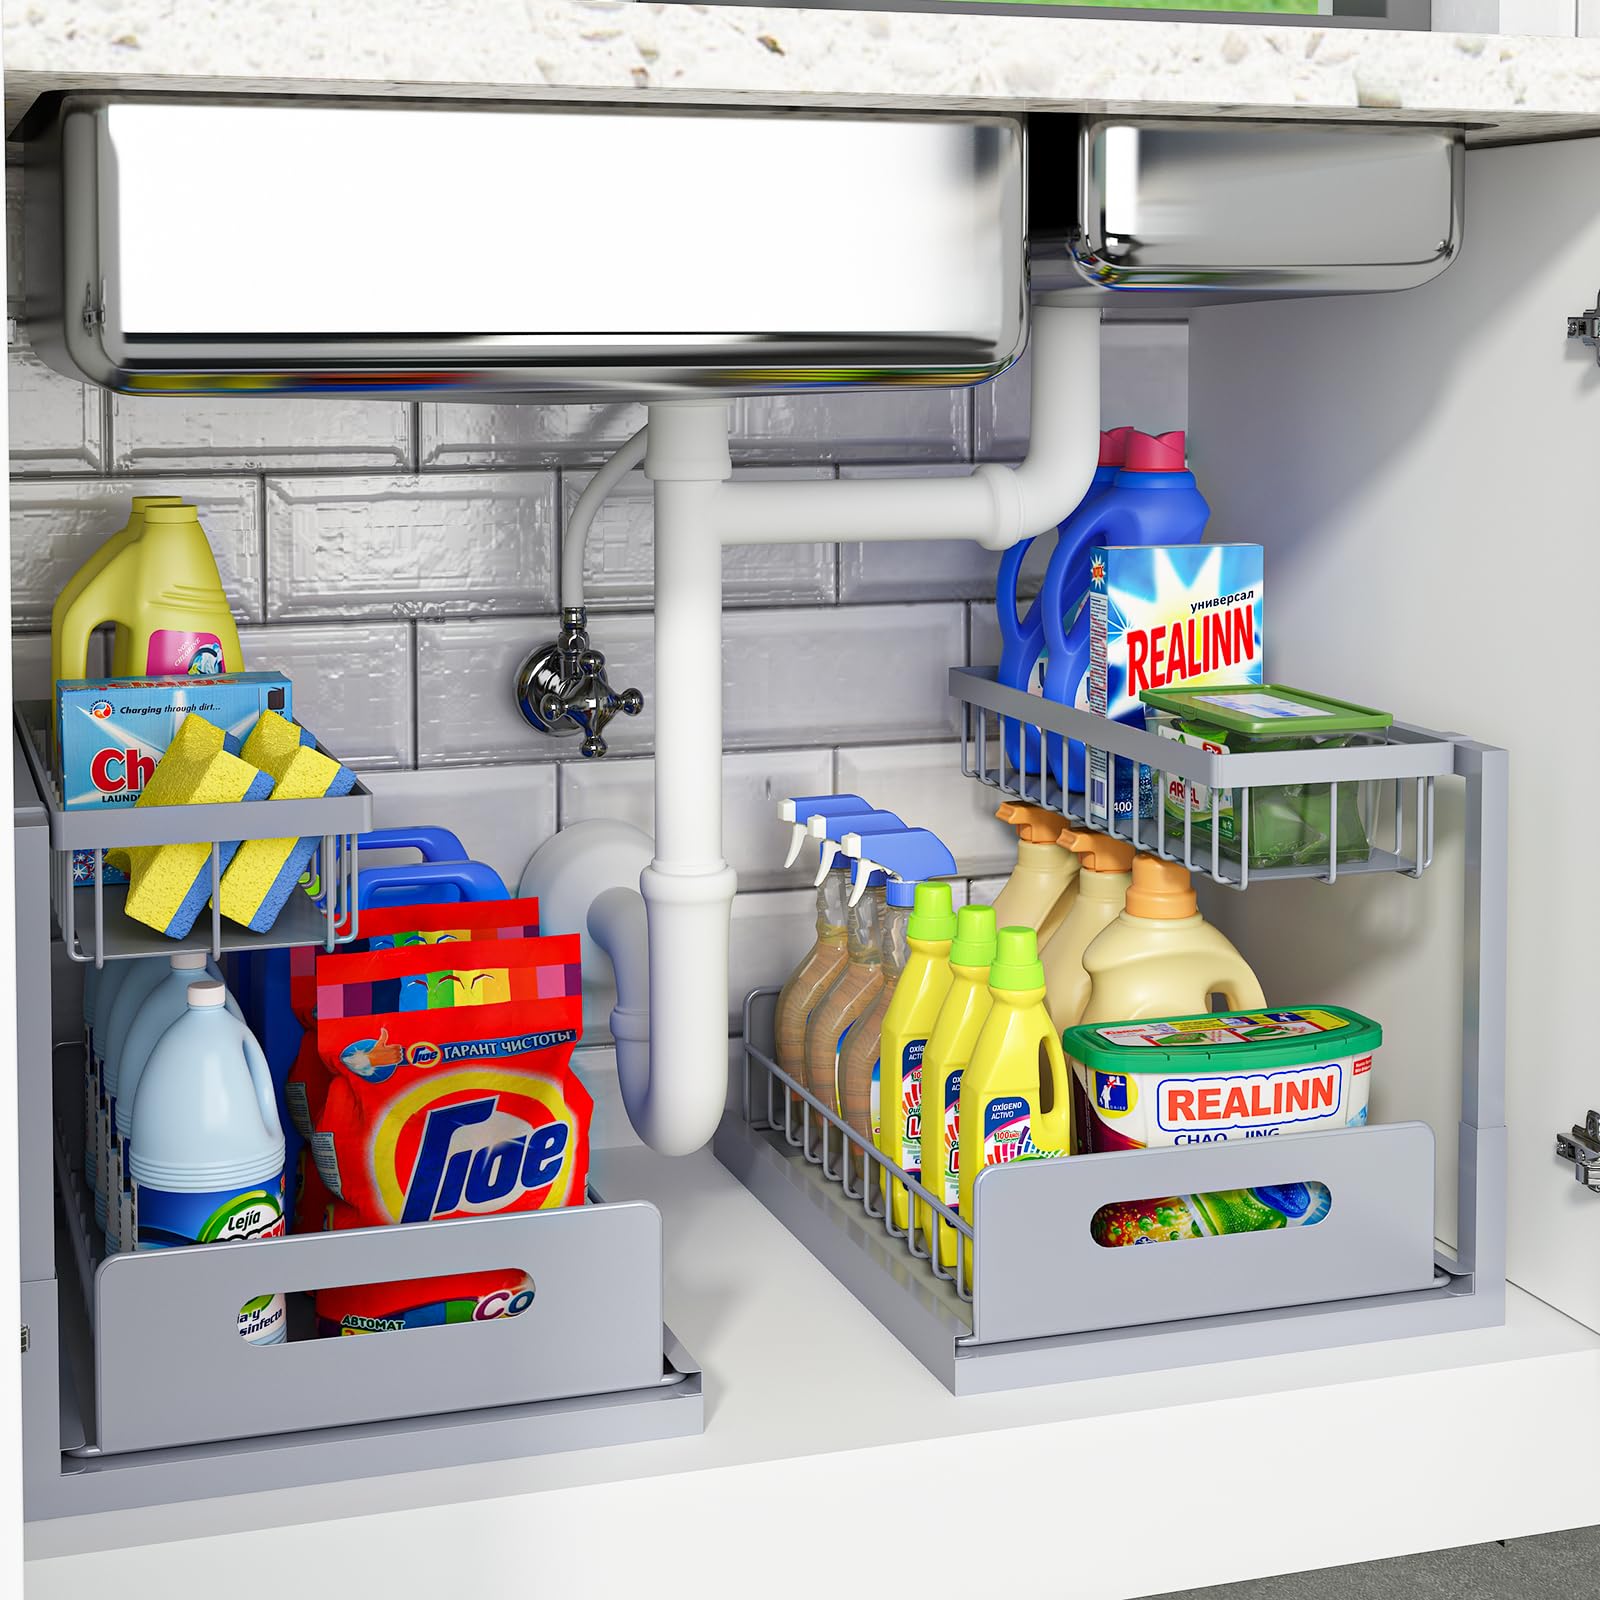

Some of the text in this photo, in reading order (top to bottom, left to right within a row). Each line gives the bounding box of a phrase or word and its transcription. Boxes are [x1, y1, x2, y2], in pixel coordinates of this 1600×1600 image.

[1190, 590, 1254, 614] универсал
[1126, 604, 1254, 697] REALINN
[120, 705, 162, 715] Charging
[164, 703, 197, 713] through
[91, 748, 156, 792] Ch
[102, 794, 141, 803] LAUND
[1169, 780, 1200, 805] ARL
[444, 1042, 498, 1060] ГАРАНТ
[501, 1030, 572, 1053] ЧИСТОТЫ
[991, 1101, 1023, 1112] OXÍGENO
[1167, 1075, 1334, 1122] REALINN
[991, 1110, 1015, 1120] ACTIVO
[228, 1209, 261, 1231] Lejía
[252, 1309, 260, 1321] y
[341, 1314, 406, 1331] АВТОМАТ
